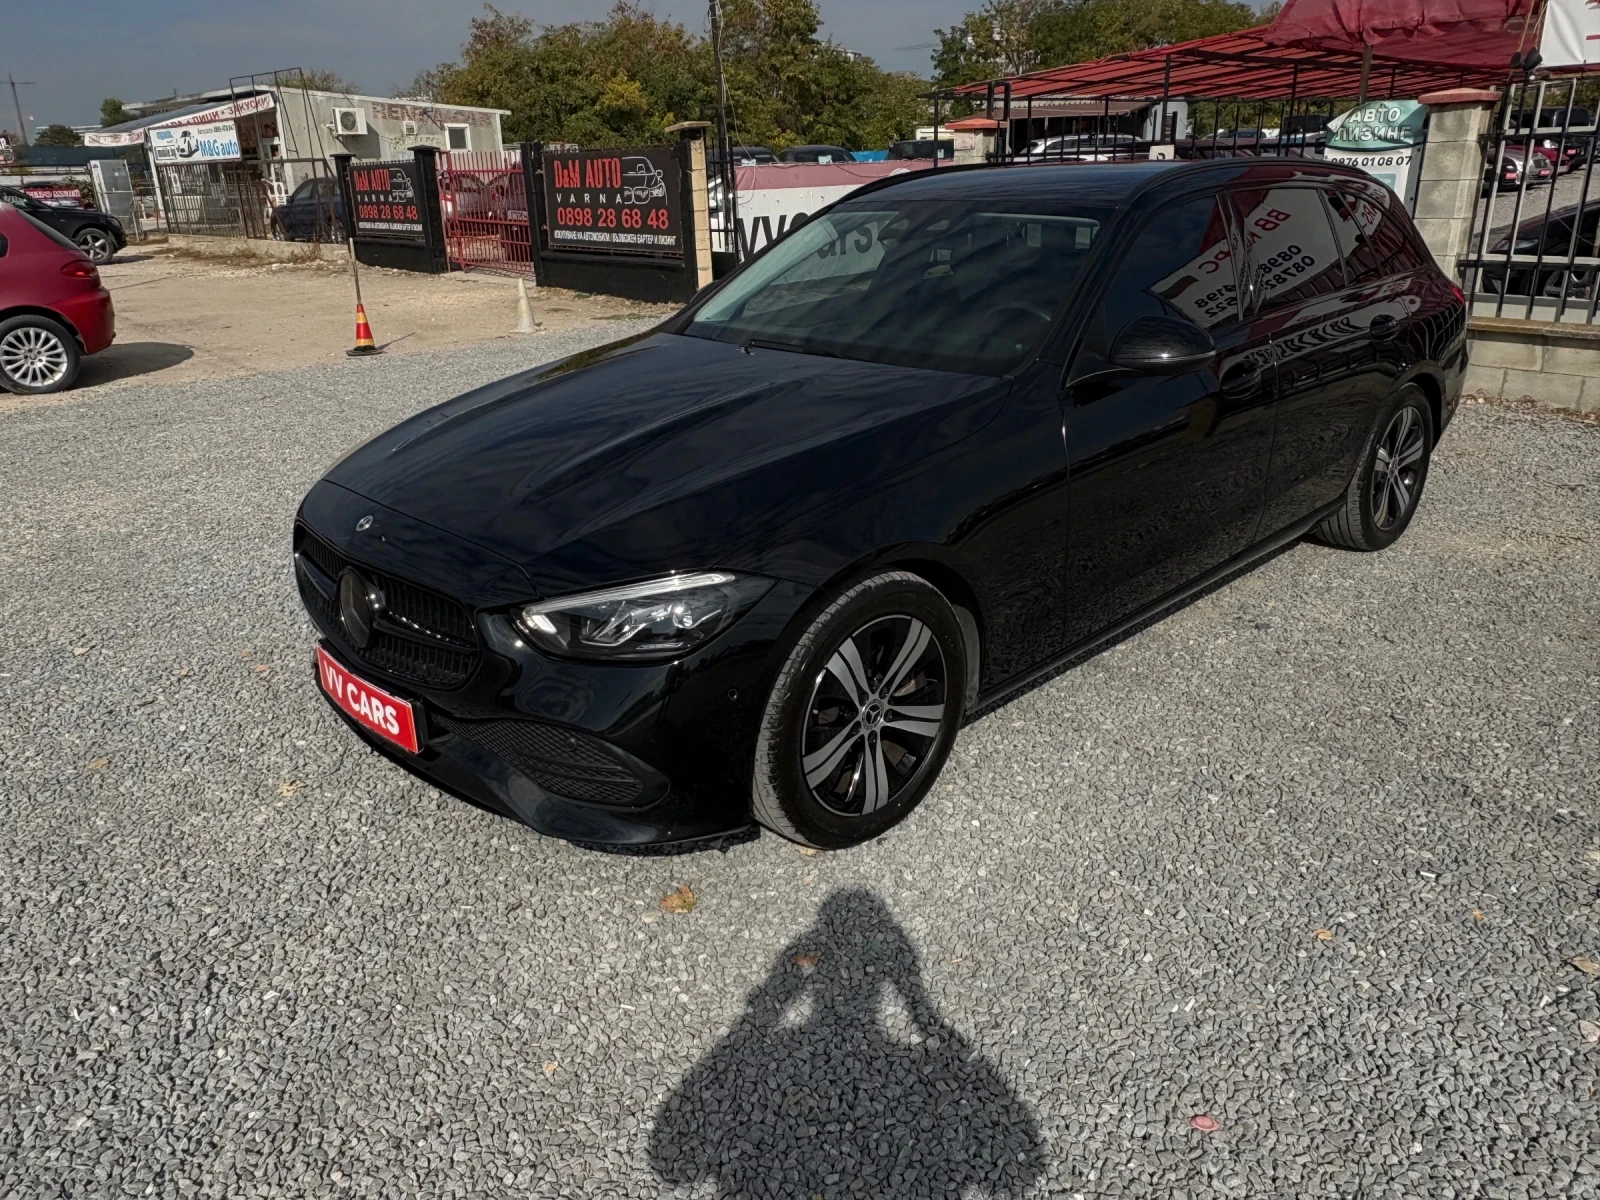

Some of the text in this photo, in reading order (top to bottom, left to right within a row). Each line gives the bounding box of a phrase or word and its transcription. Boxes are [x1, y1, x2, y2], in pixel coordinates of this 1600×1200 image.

[1349, 107, 1401, 123] АВТО
[1333, 126, 1412, 141] ЛИЗИНГ
[200, 139, 239, 157] M&G auto
[1361, 157, 1375, 167] 01
[1377, 157, 1393, 167] 08
[1395, 156, 1412, 166] 07
[371, 169, 391, 191] AUTO
[554, 158, 622, 188] D&M AUTO
[357, 194, 393, 202] VARNA
[556, 193, 622, 204] VARNA
[359, 204, 418, 220] 0898 28 68 48
[557, 207, 669, 230] 0898 28 68 48
[323, 660, 400, 735] VV CARS
